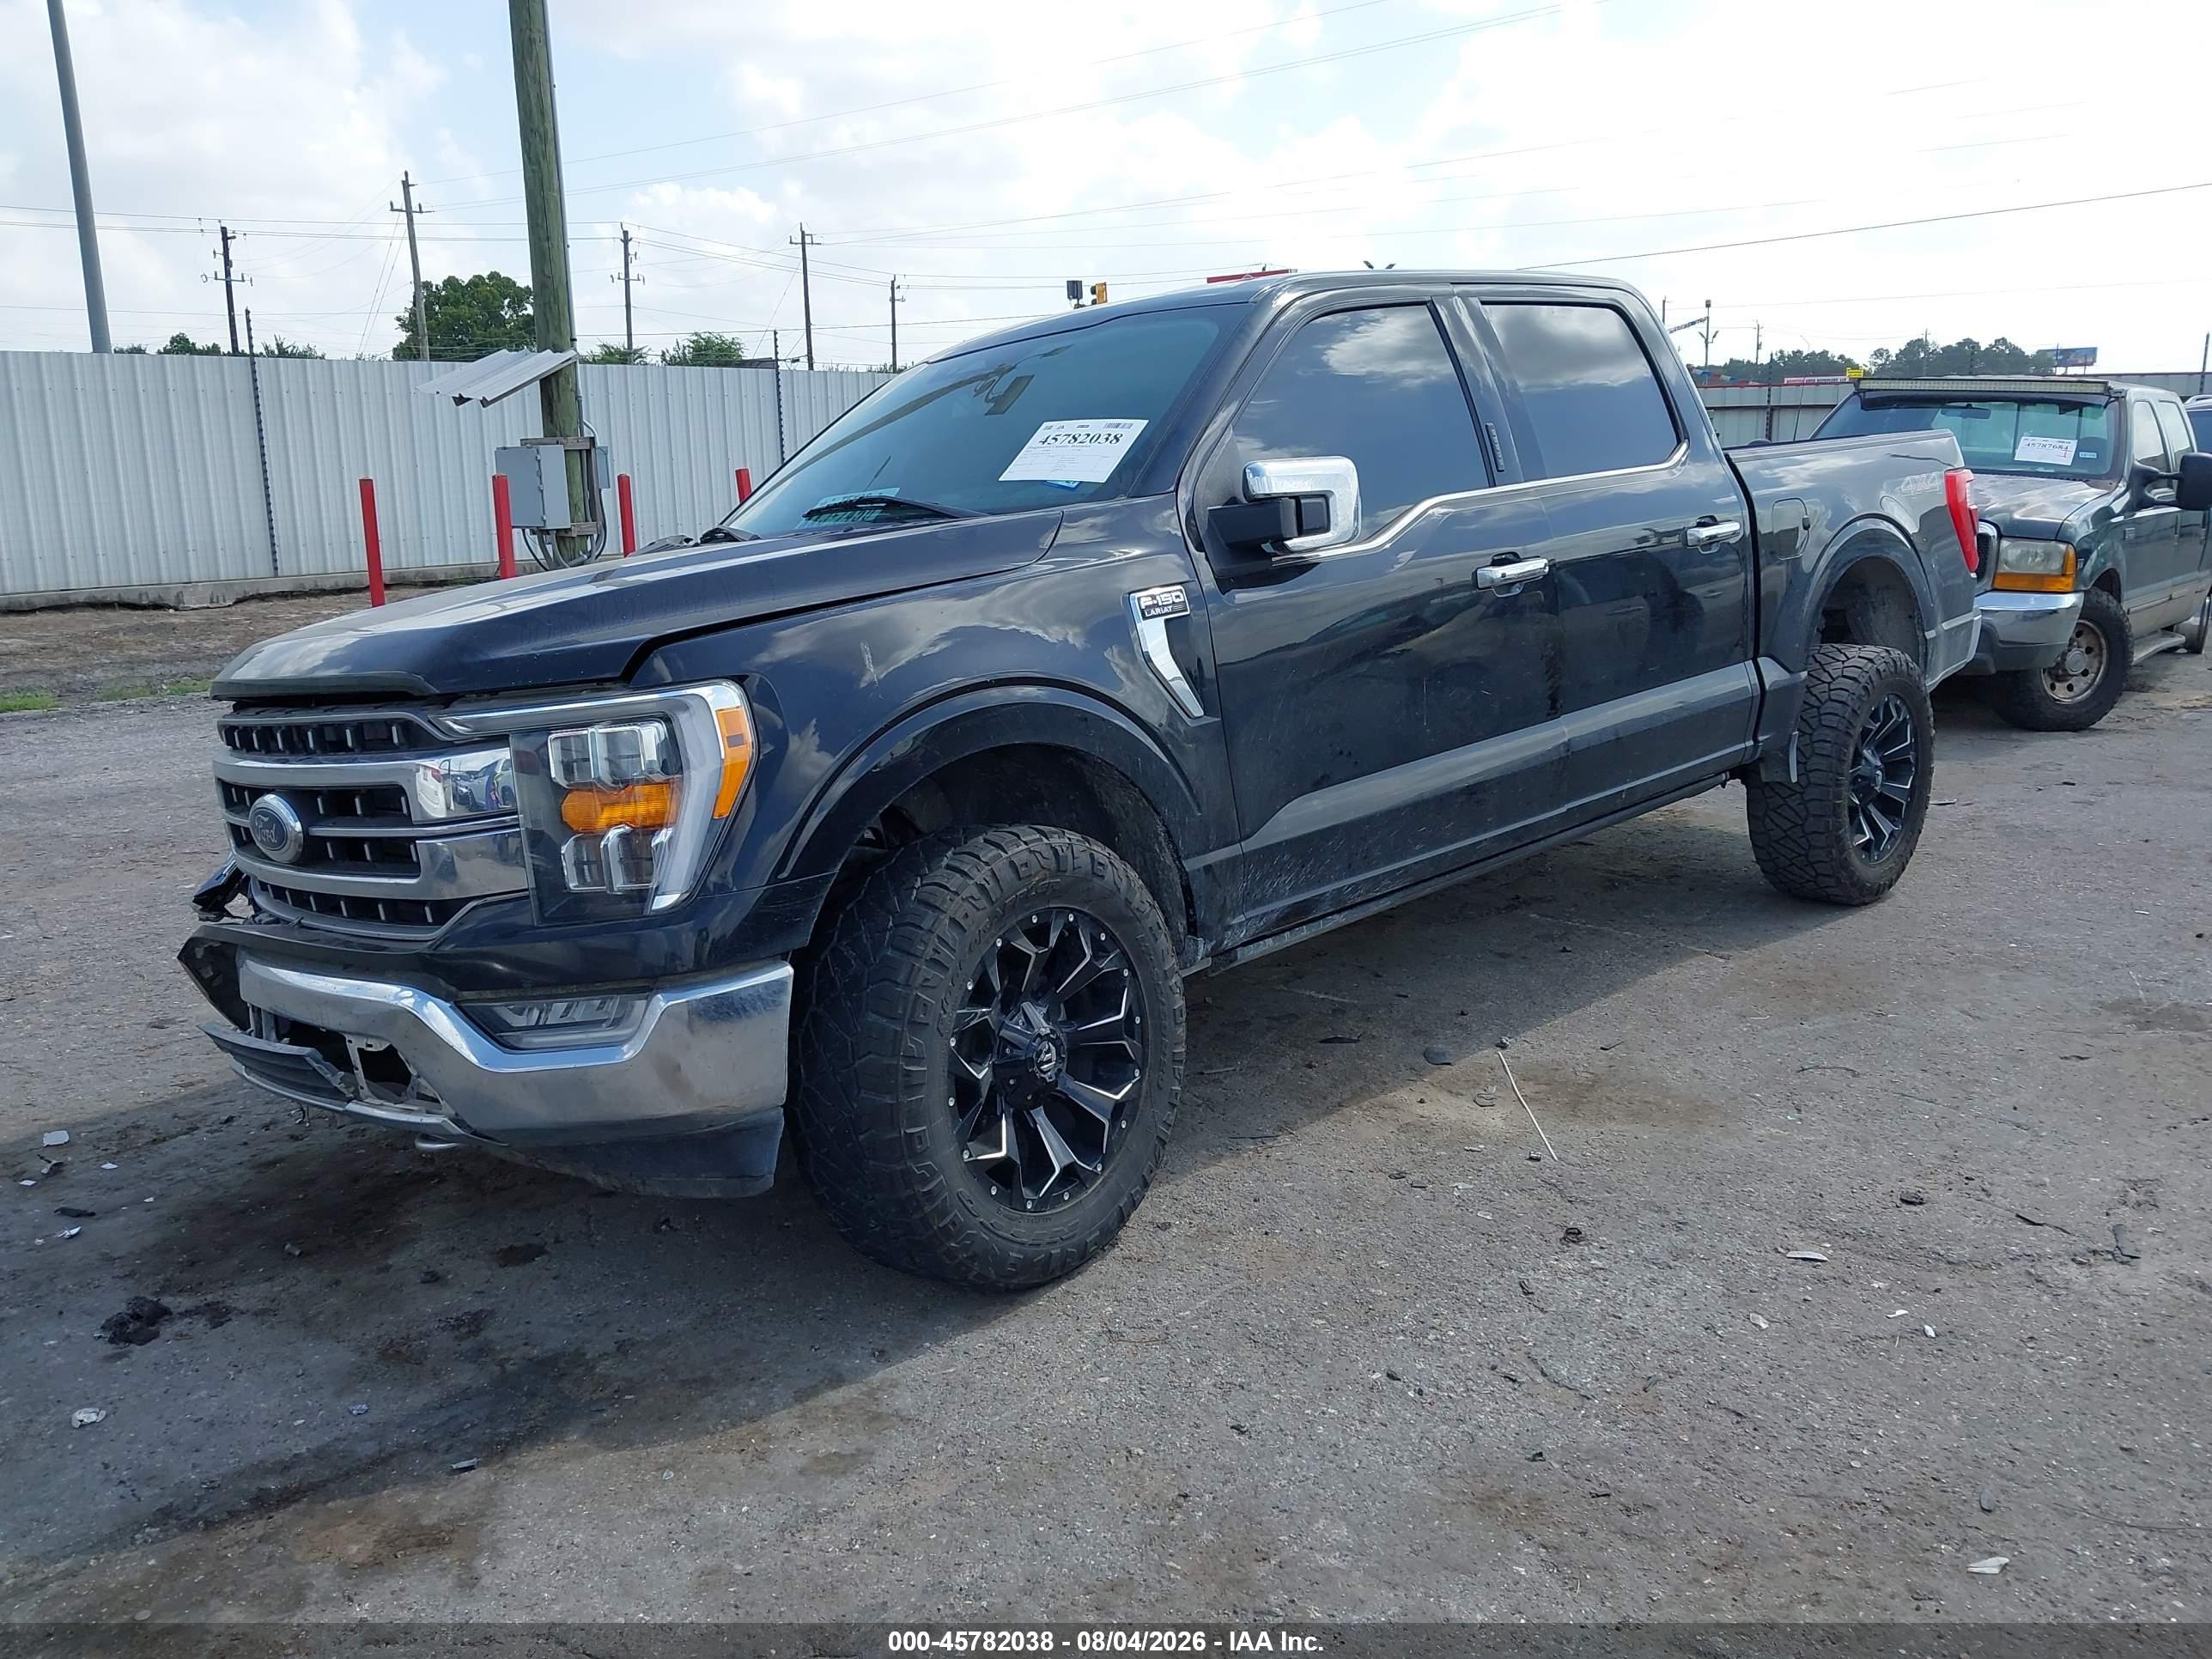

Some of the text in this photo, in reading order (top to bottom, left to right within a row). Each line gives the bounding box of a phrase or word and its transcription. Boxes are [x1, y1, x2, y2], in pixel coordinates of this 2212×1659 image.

[1038, 432, 1124, 446] 45782038
[1139, 590, 1185, 610] F-150
[1144, 605, 1173, 617] LARIAT
[255, 813, 277, 843] Ford
